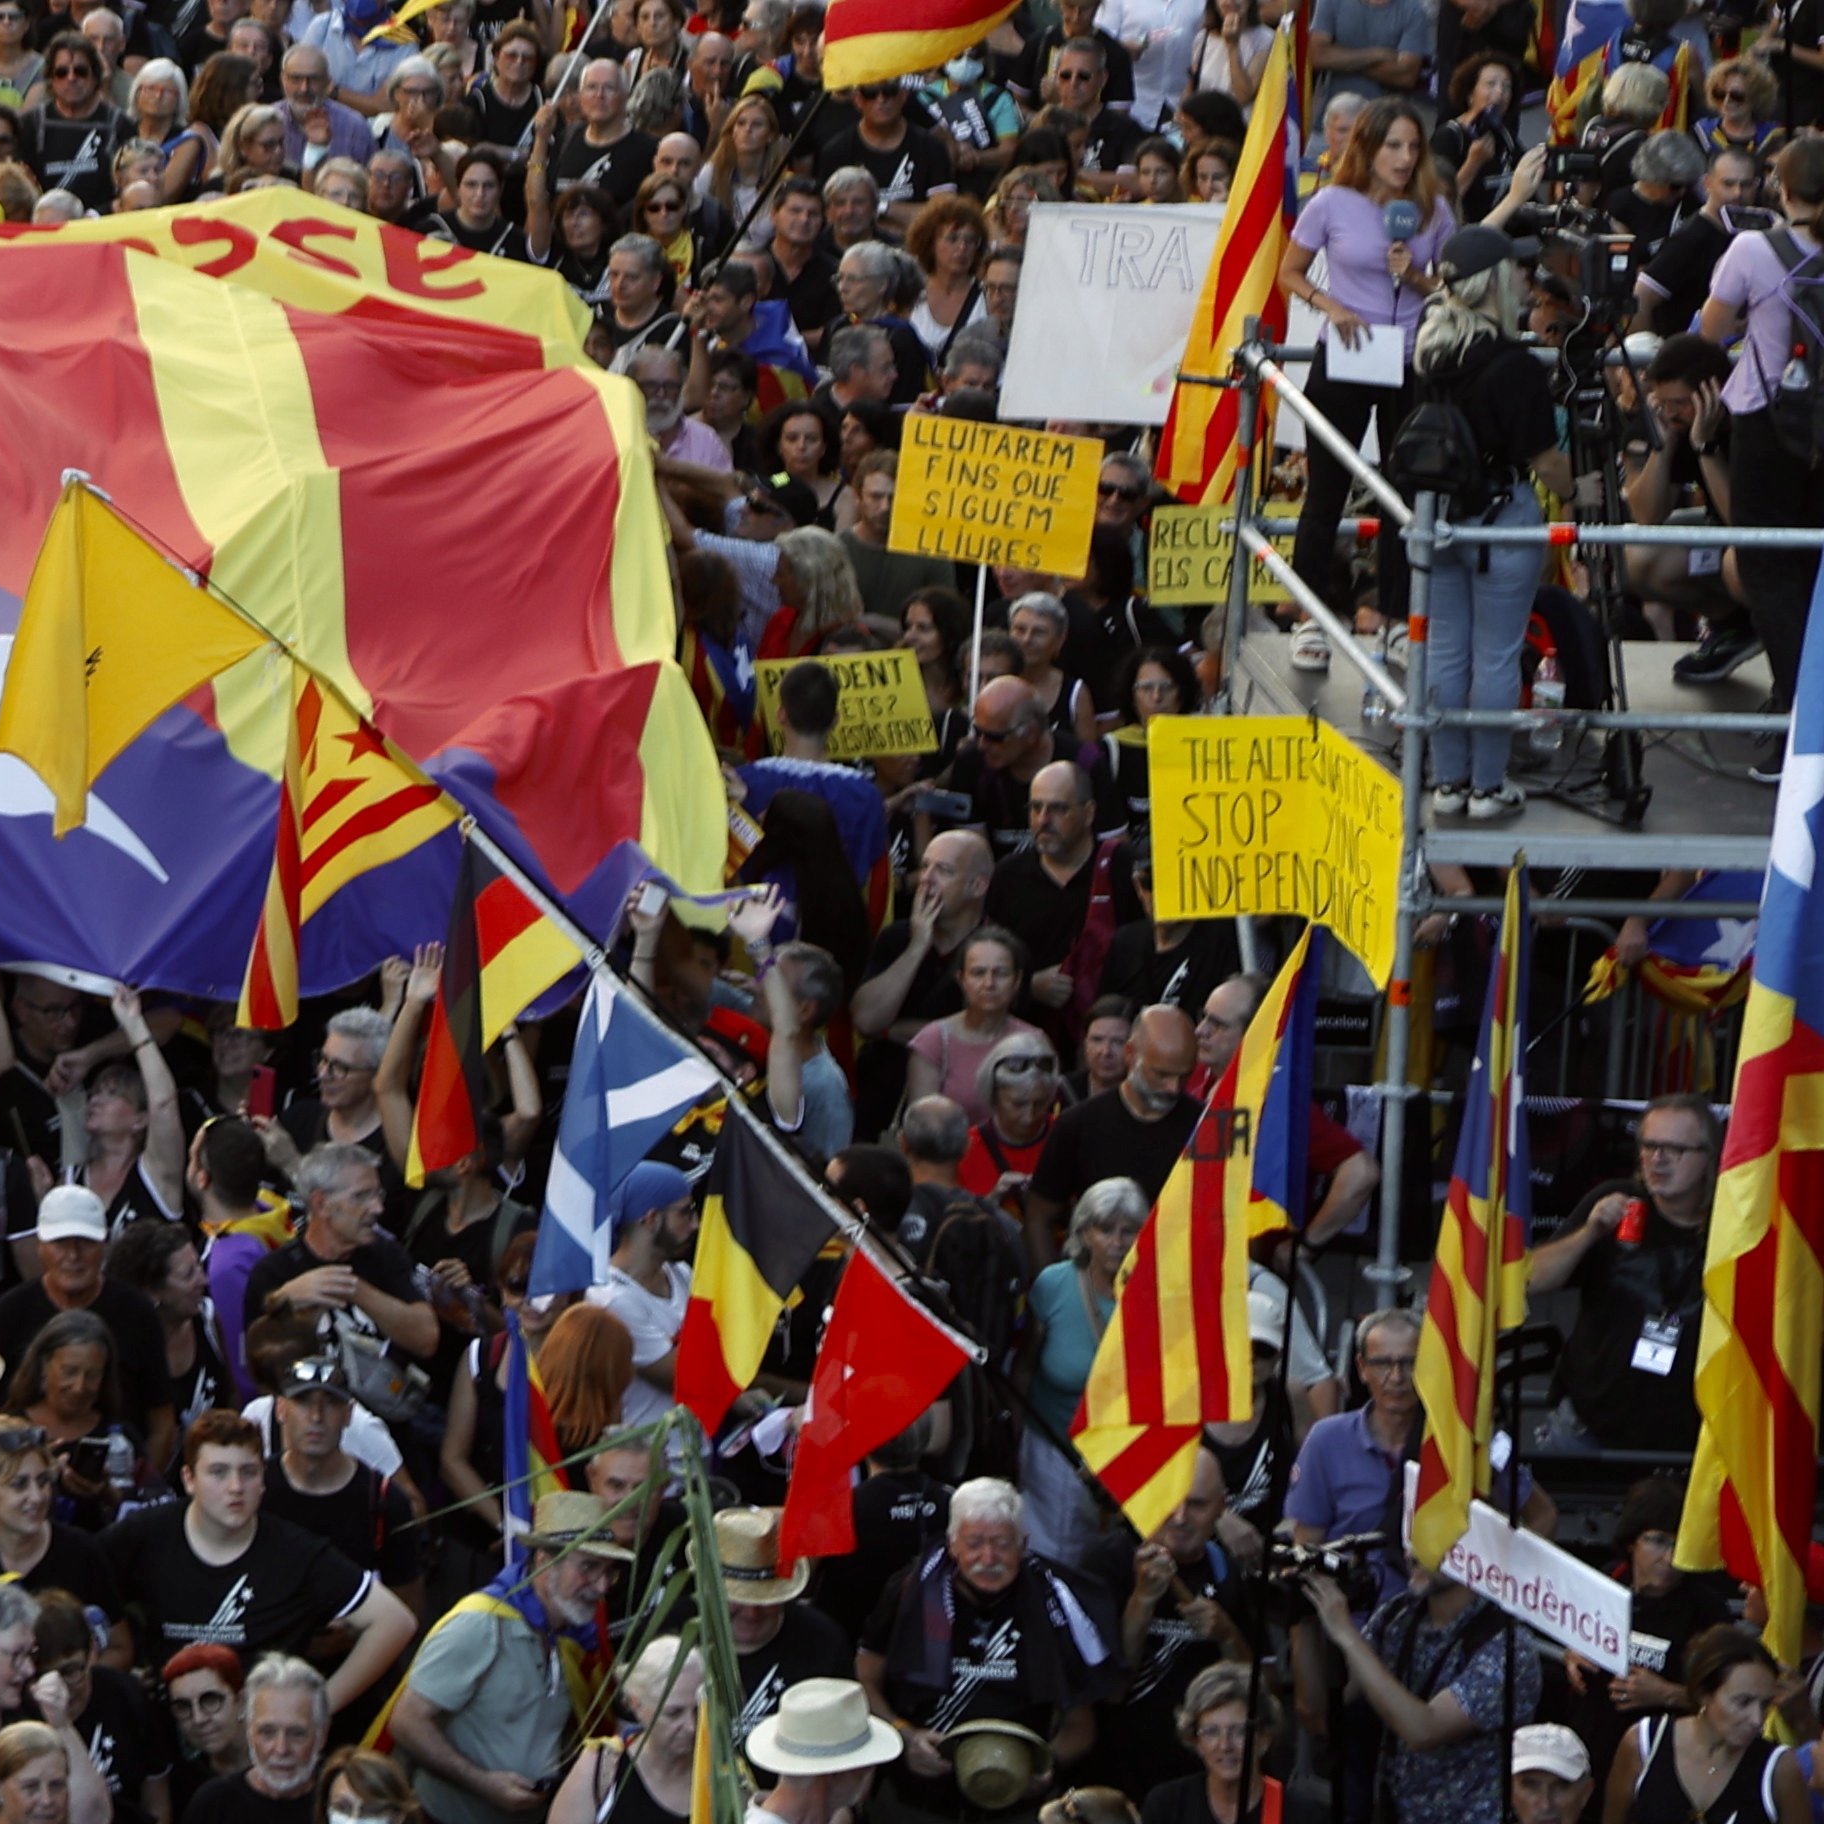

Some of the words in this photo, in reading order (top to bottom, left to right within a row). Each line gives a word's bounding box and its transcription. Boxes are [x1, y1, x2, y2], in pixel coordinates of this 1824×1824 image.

[1071, 219, 1194, 292] TRA
[913, 418, 1075, 470] LLUITAREM
[926, 454, 1001, 491] FINS
[1012, 469, 1067, 504] QUE
[921, 488, 1054, 534] SIGUEM
[917, 525, 1043, 568] LLIURES
[1153, 556, 1193, 590] ELS
[1181, 736, 1239, 785] THE
[1182, 788, 1282, 848] STOP
[1315, 1014, 1369, 1030] arcelona
